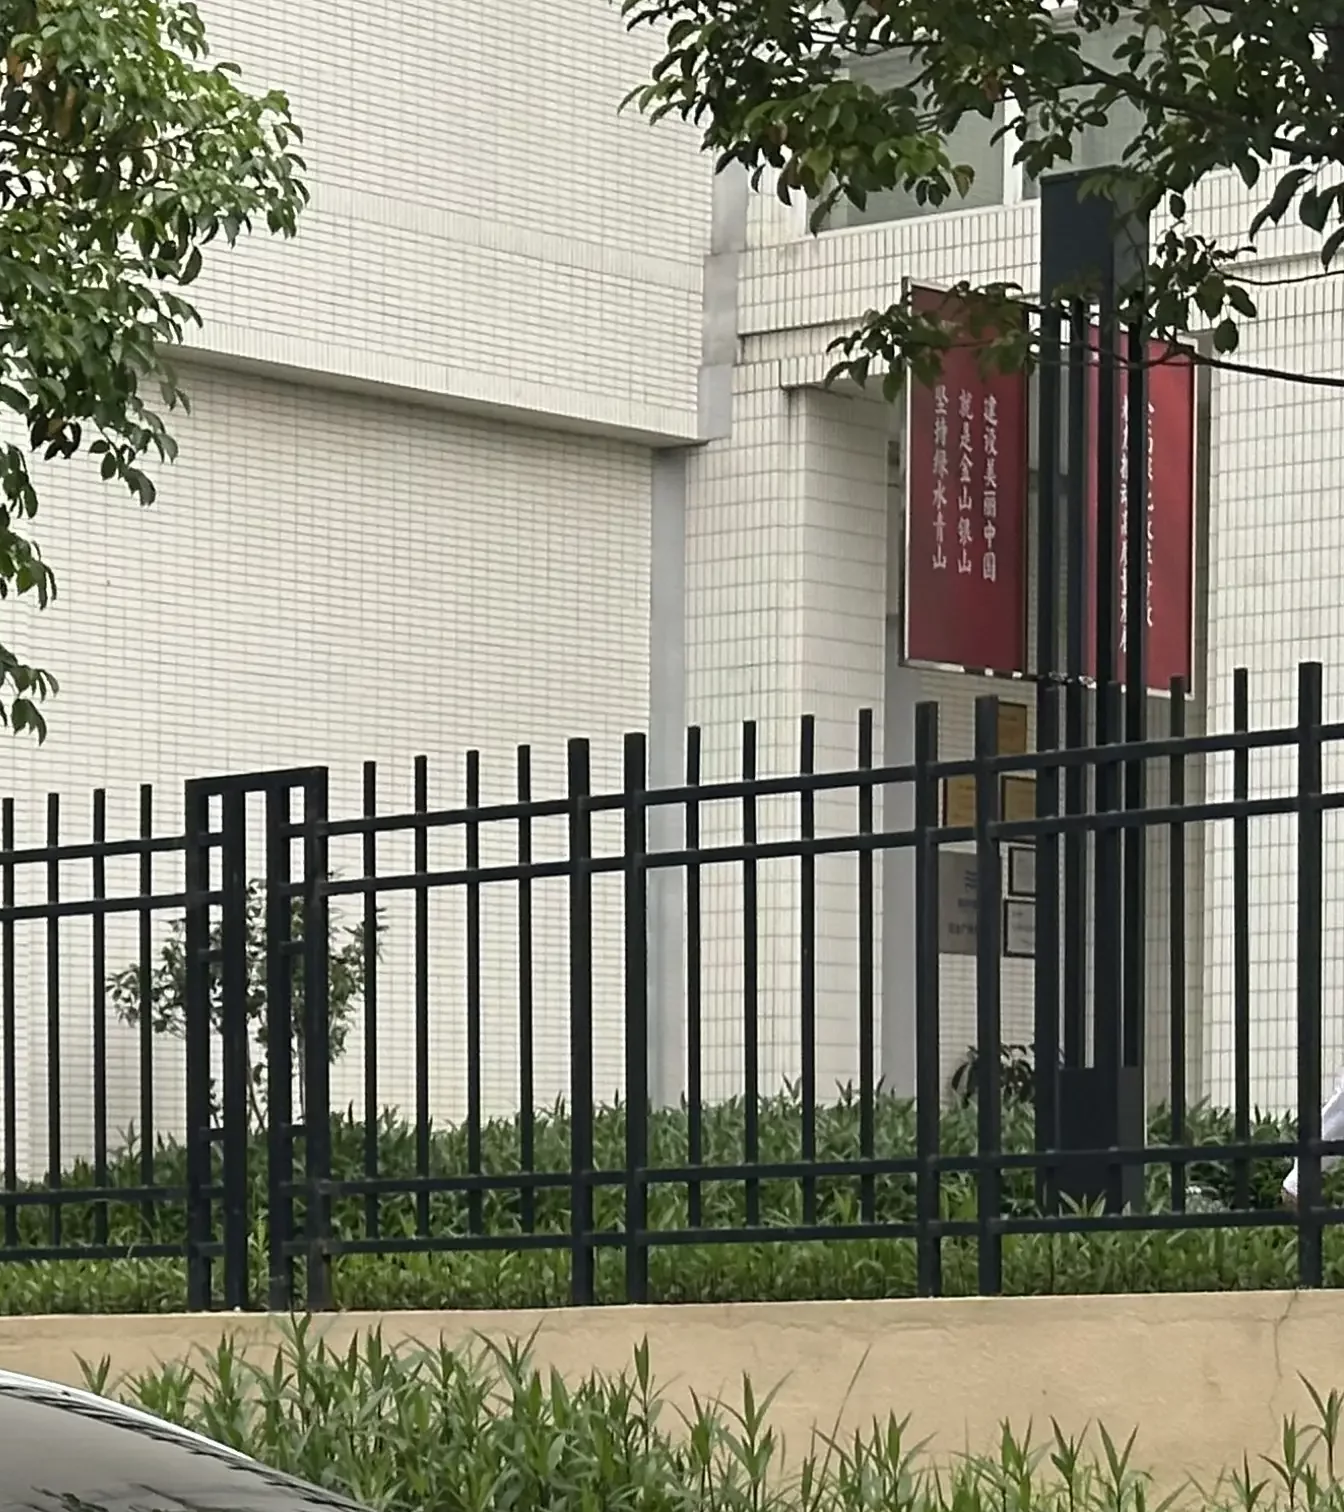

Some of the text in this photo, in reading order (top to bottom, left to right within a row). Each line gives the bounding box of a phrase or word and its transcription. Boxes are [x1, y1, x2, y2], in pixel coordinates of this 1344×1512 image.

[932, 384, 949, 570] 坚持绿水青山
[958, 388, 974, 575] 就是金山银山
[983, 393, 998, 583] 建设美丽中国
